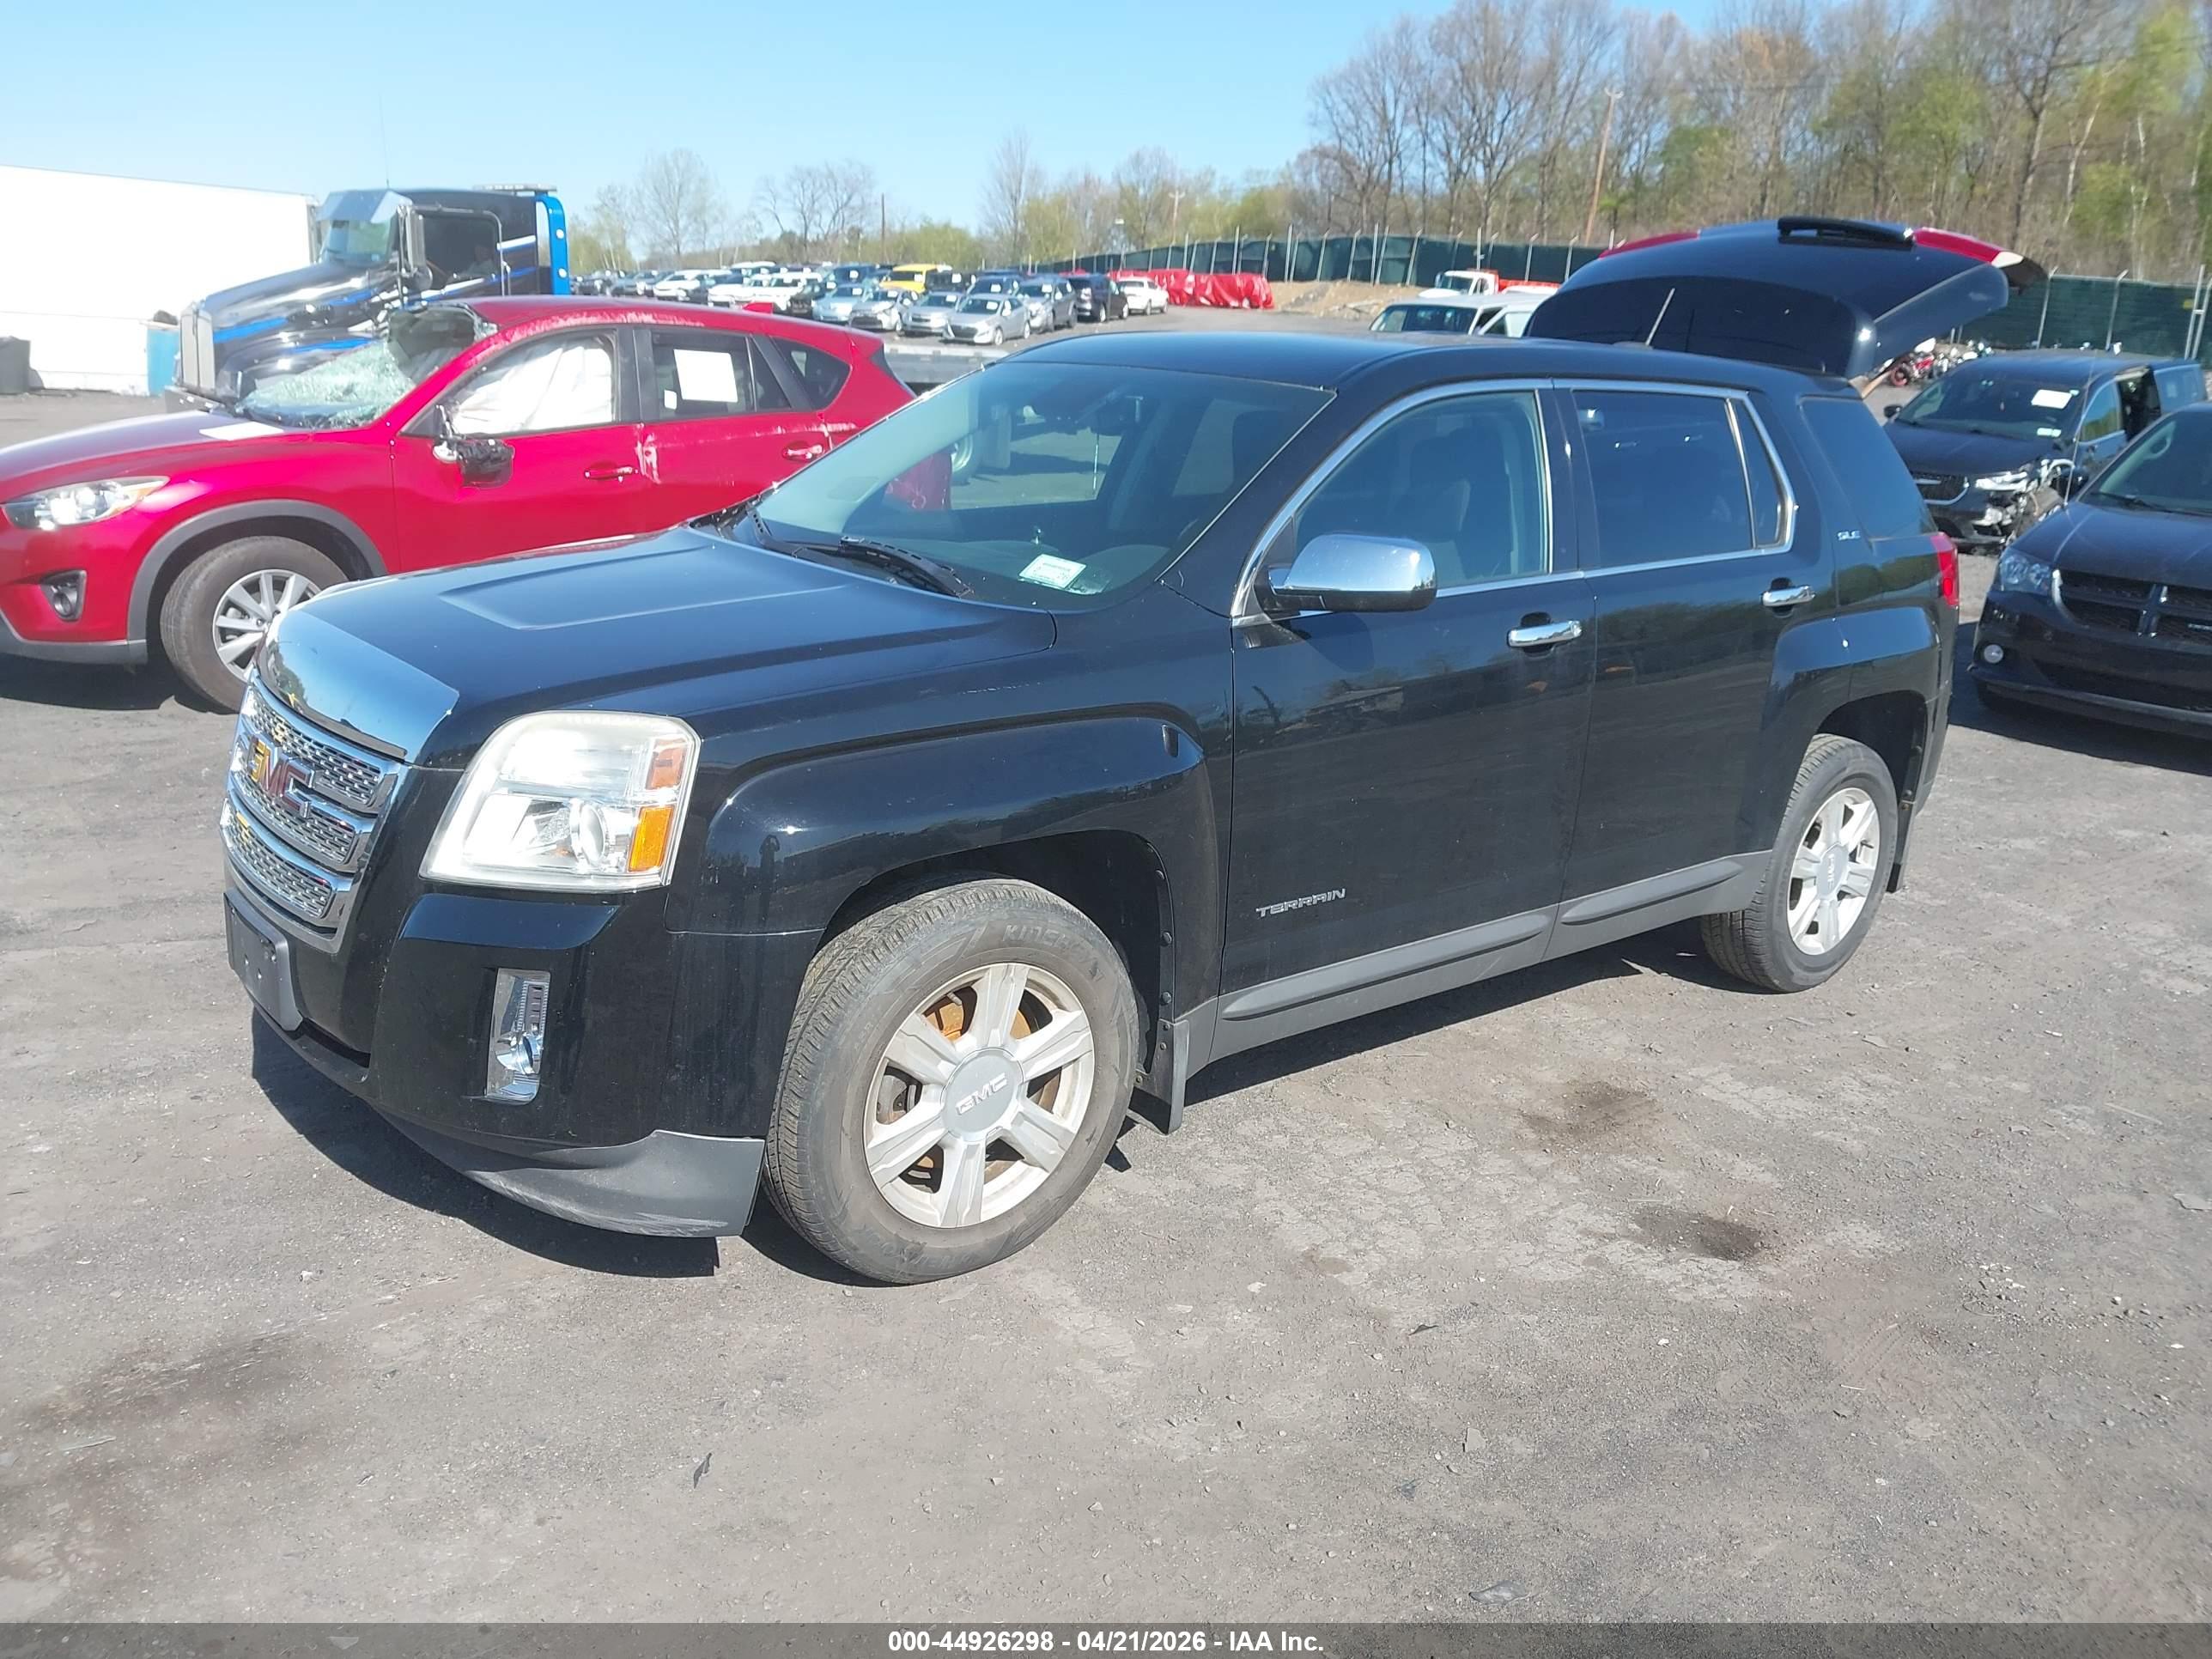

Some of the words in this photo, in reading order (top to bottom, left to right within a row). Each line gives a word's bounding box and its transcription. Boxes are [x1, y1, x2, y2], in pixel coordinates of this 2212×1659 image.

[247, 735, 315, 818] GMC
[1255, 888, 1346, 918] TERRAIN
[955, 1072, 1008, 1115] GMC
